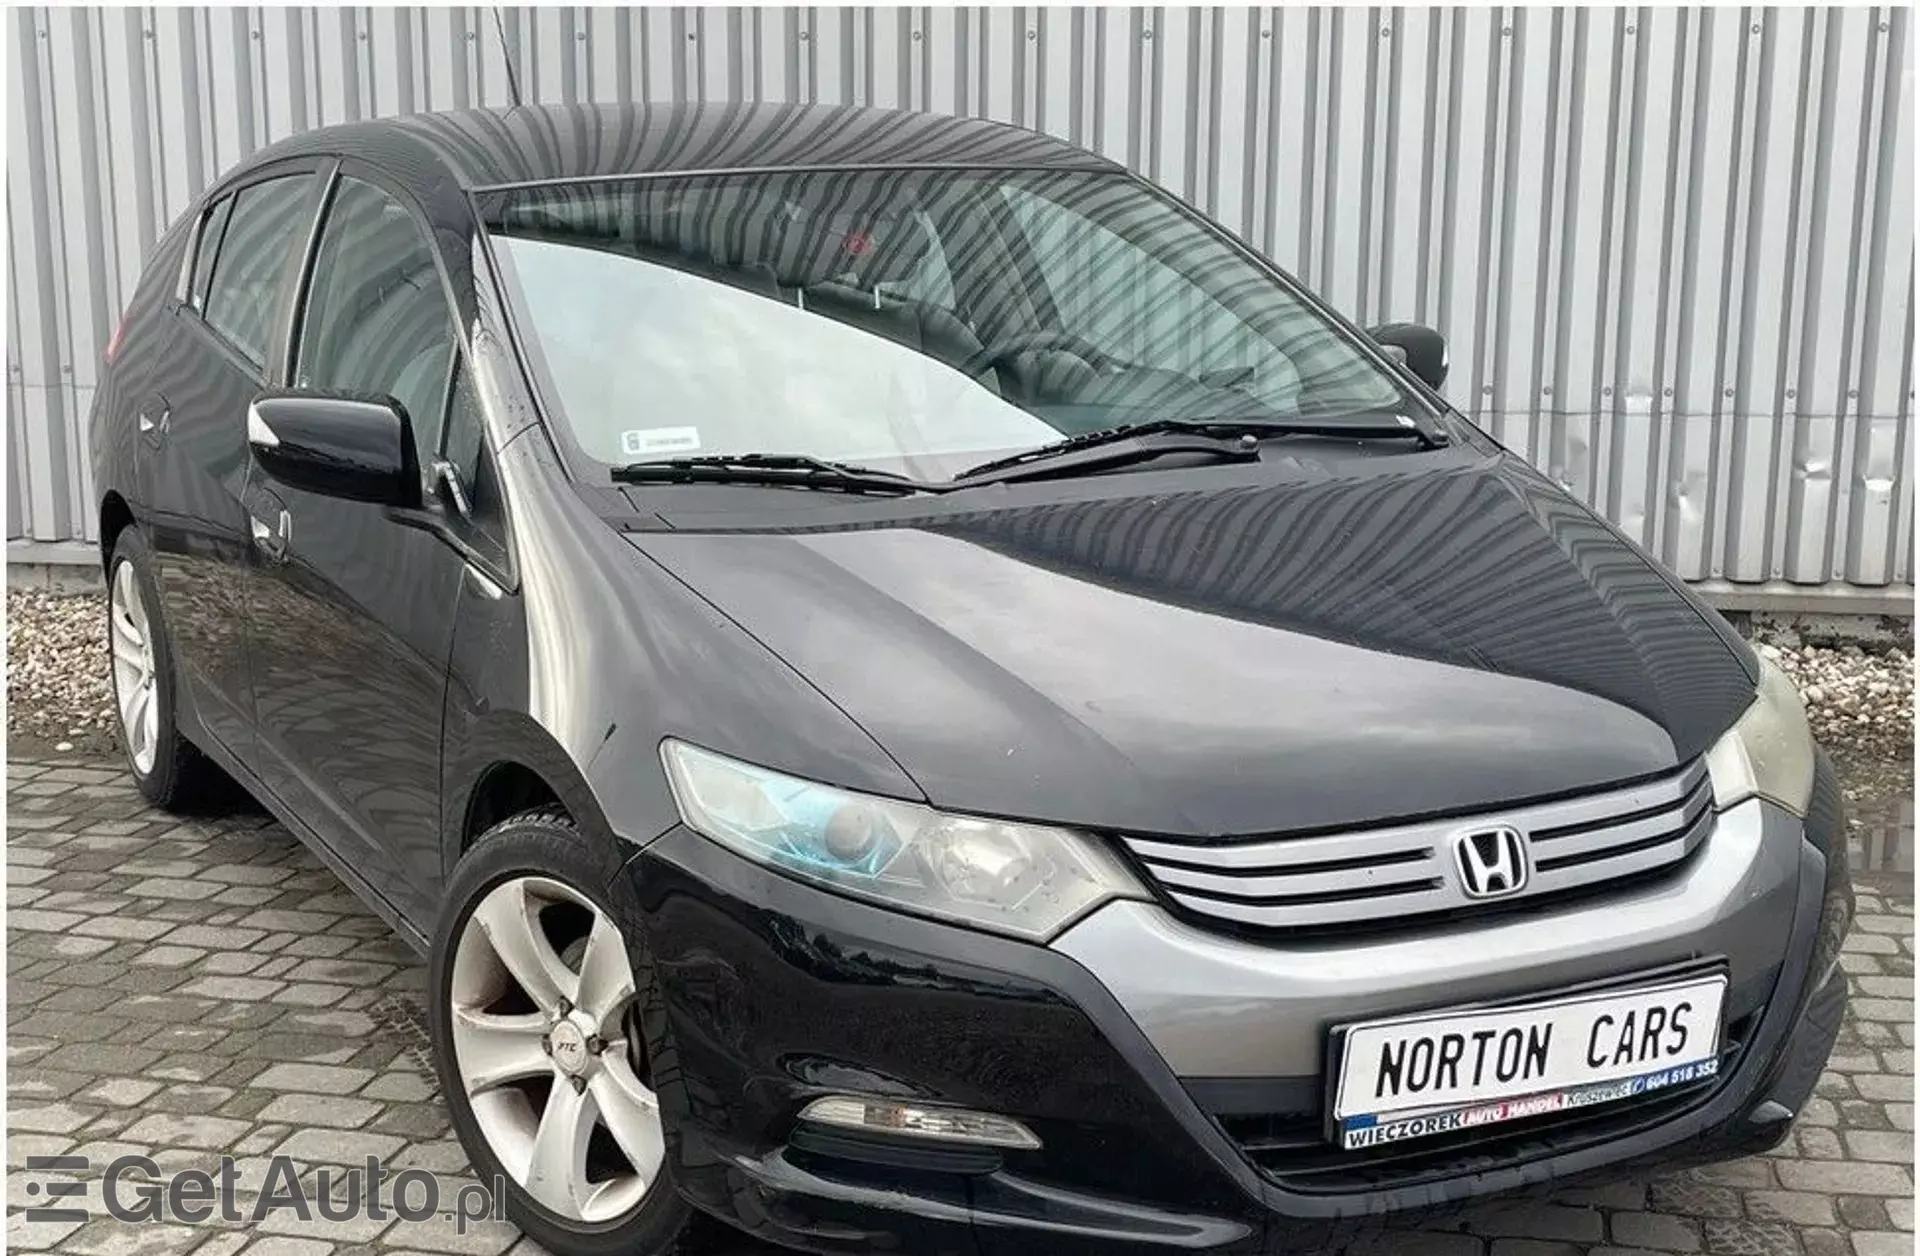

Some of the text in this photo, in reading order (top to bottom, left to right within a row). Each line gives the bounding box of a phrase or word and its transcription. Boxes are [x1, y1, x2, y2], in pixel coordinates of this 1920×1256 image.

[1375, 1002, 1693, 1098] NORTON CARS
[1348, 1112, 1462, 1148] WIECZOREK
[1466, 1104, 1503, 1126] AUTO
[1509, 1092, 1562, 1118] HANDEL
[1646, 1073, 1669, 1090] 604
[1671, 1066, 1694, 1084] 518
[1696, 1060, 1719, 1080] 352
